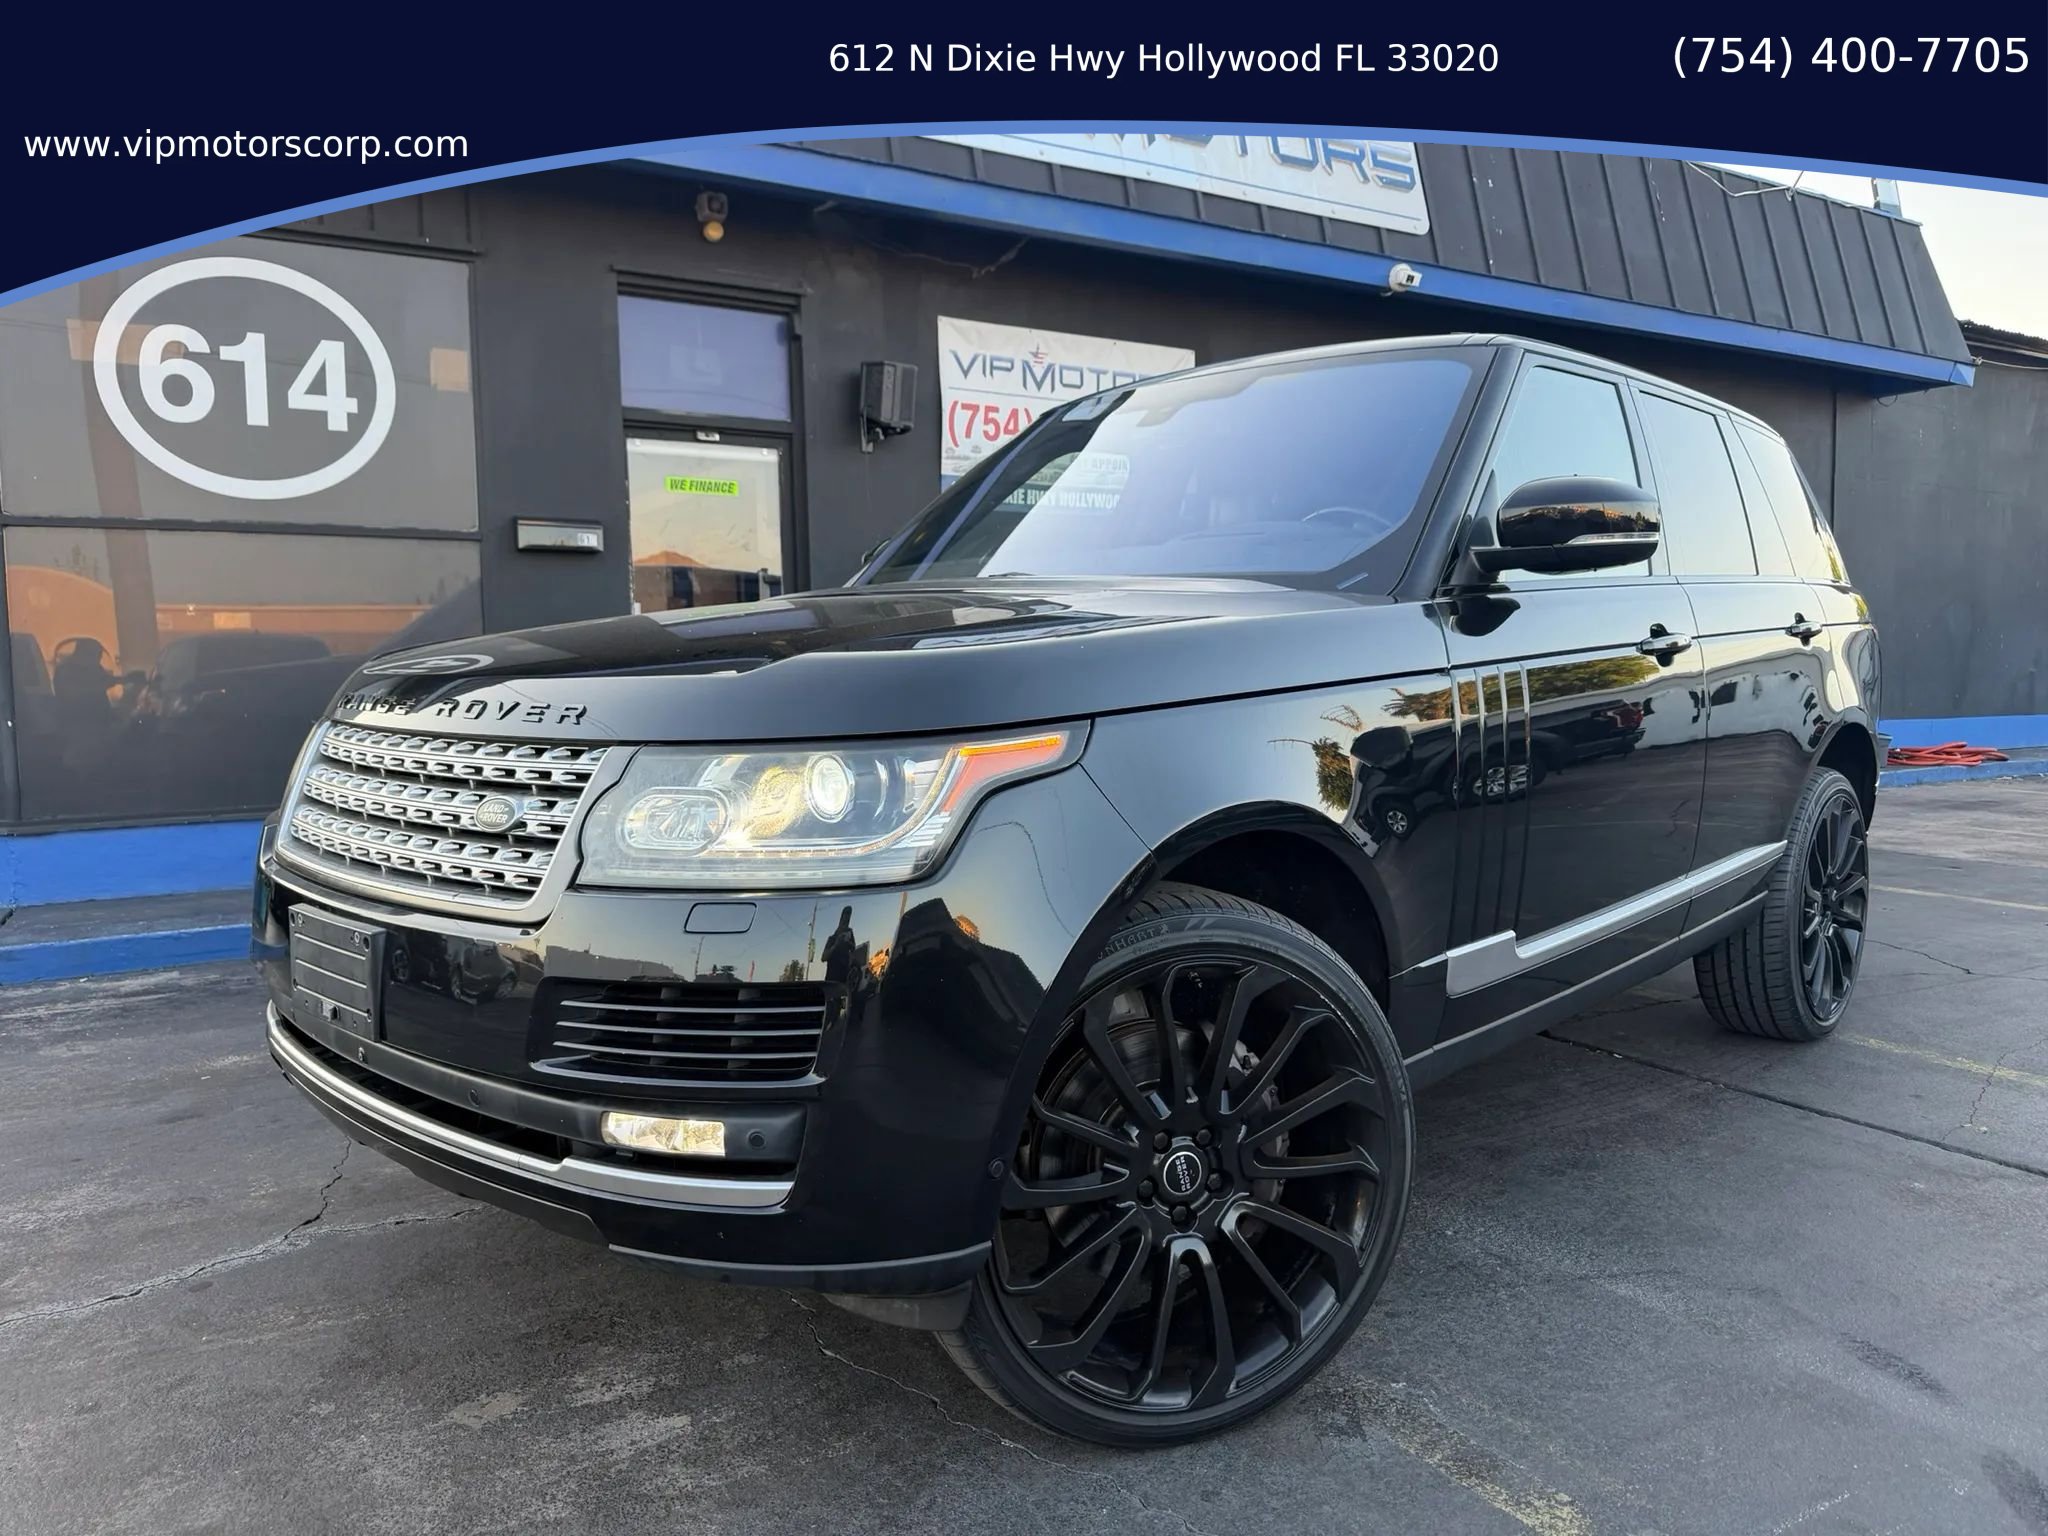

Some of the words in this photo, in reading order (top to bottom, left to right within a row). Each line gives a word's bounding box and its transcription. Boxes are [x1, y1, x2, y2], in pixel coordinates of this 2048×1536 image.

[139, 323, 358, 432] 614
[949, 349, 1014, 380] VIP
[670, 478, 688, 491] WE
[689, 480, 736, 494] FINANCE
[337, 692, 417, 716] RANGE
[435, 697, 588, 726] ROVER
[481, 812, 508, 824] ROVER
[1175, 1158, 1186, 1192] RANGE
[1180, 1155, 1191, 1190] ROVER
